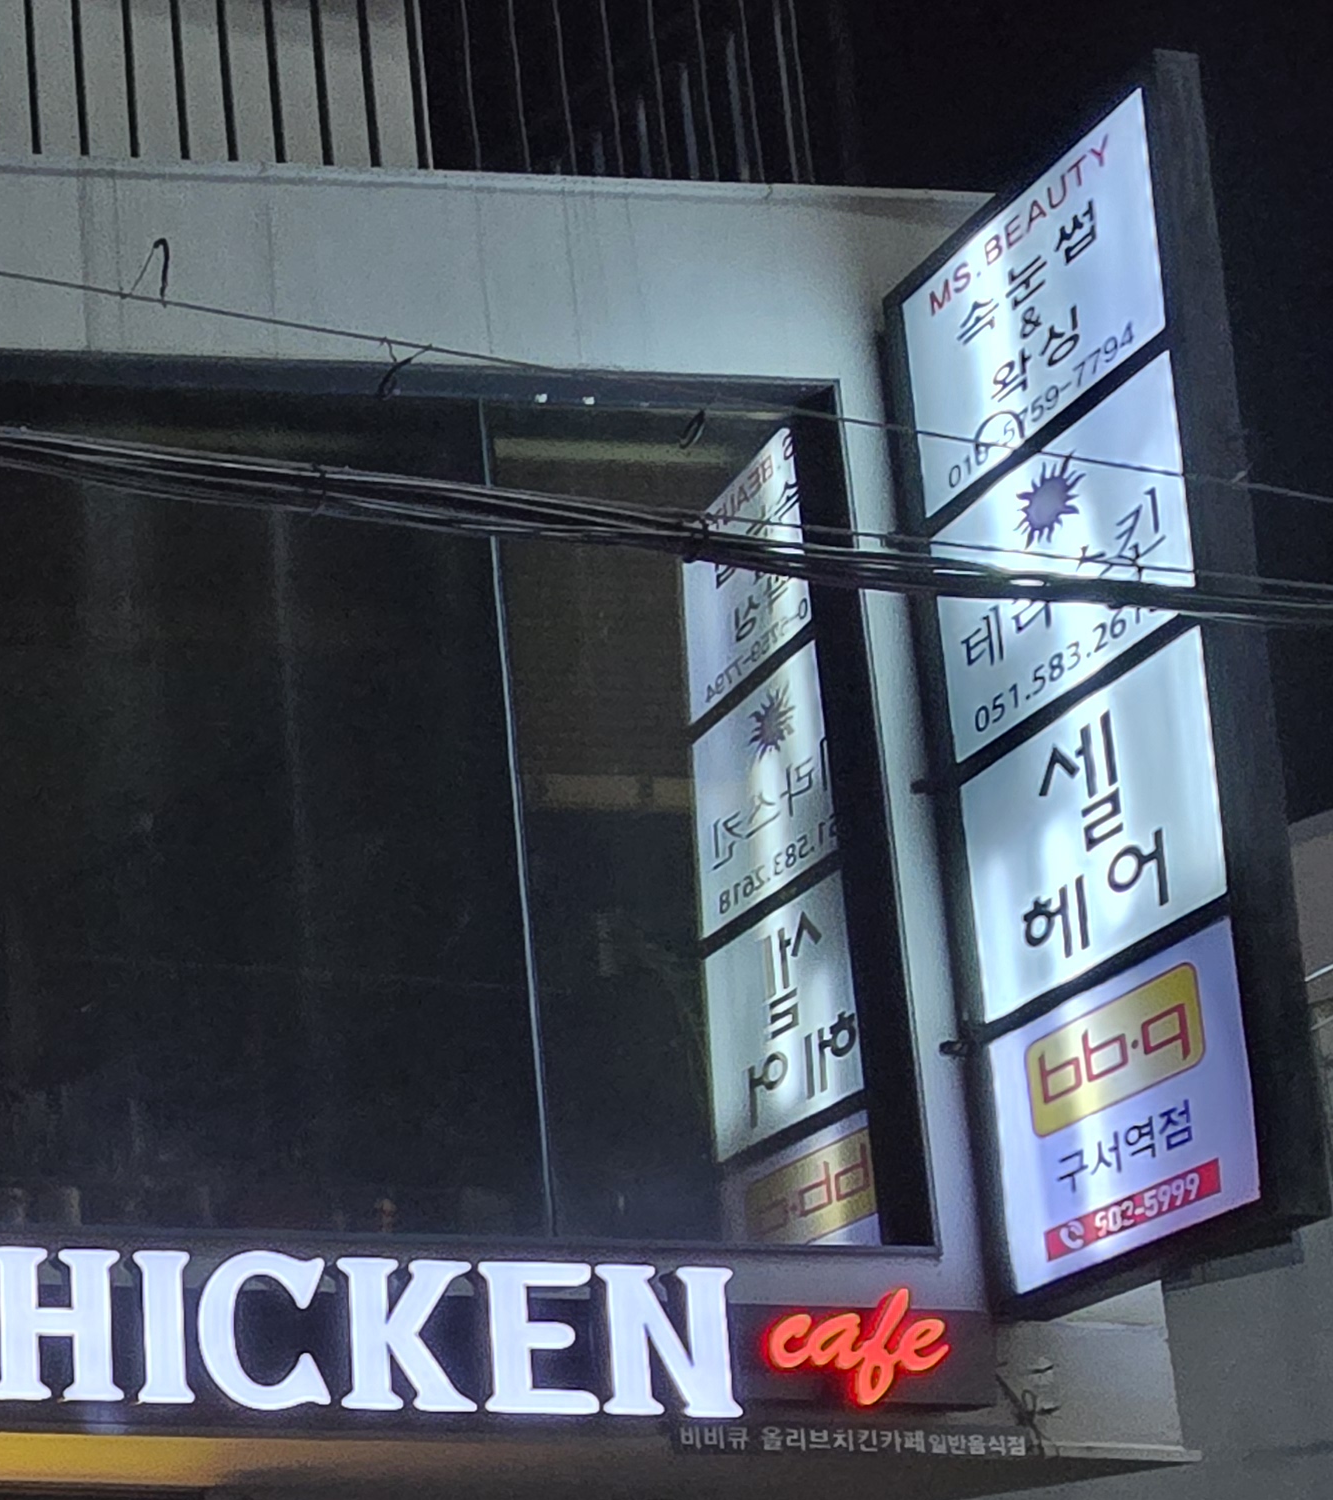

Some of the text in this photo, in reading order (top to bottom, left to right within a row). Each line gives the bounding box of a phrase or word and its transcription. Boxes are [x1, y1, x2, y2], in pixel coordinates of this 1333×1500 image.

[955, 200, 1099, 346] 속눈썹
[1018, 306, 1043, 340] &
[991, 307, 1082, 403] 왁싱
[974, 606, 1162, 732] 051.583.261
[1037, 711, 1123, 853] 셀
[1022, 829, 1170, 959] 헤어
[1056, 1098, 1194, 1194] 구서역점
[766, 1287, 950, 1406] cafe
[679, 1426, 749, 1450] 비비큐
